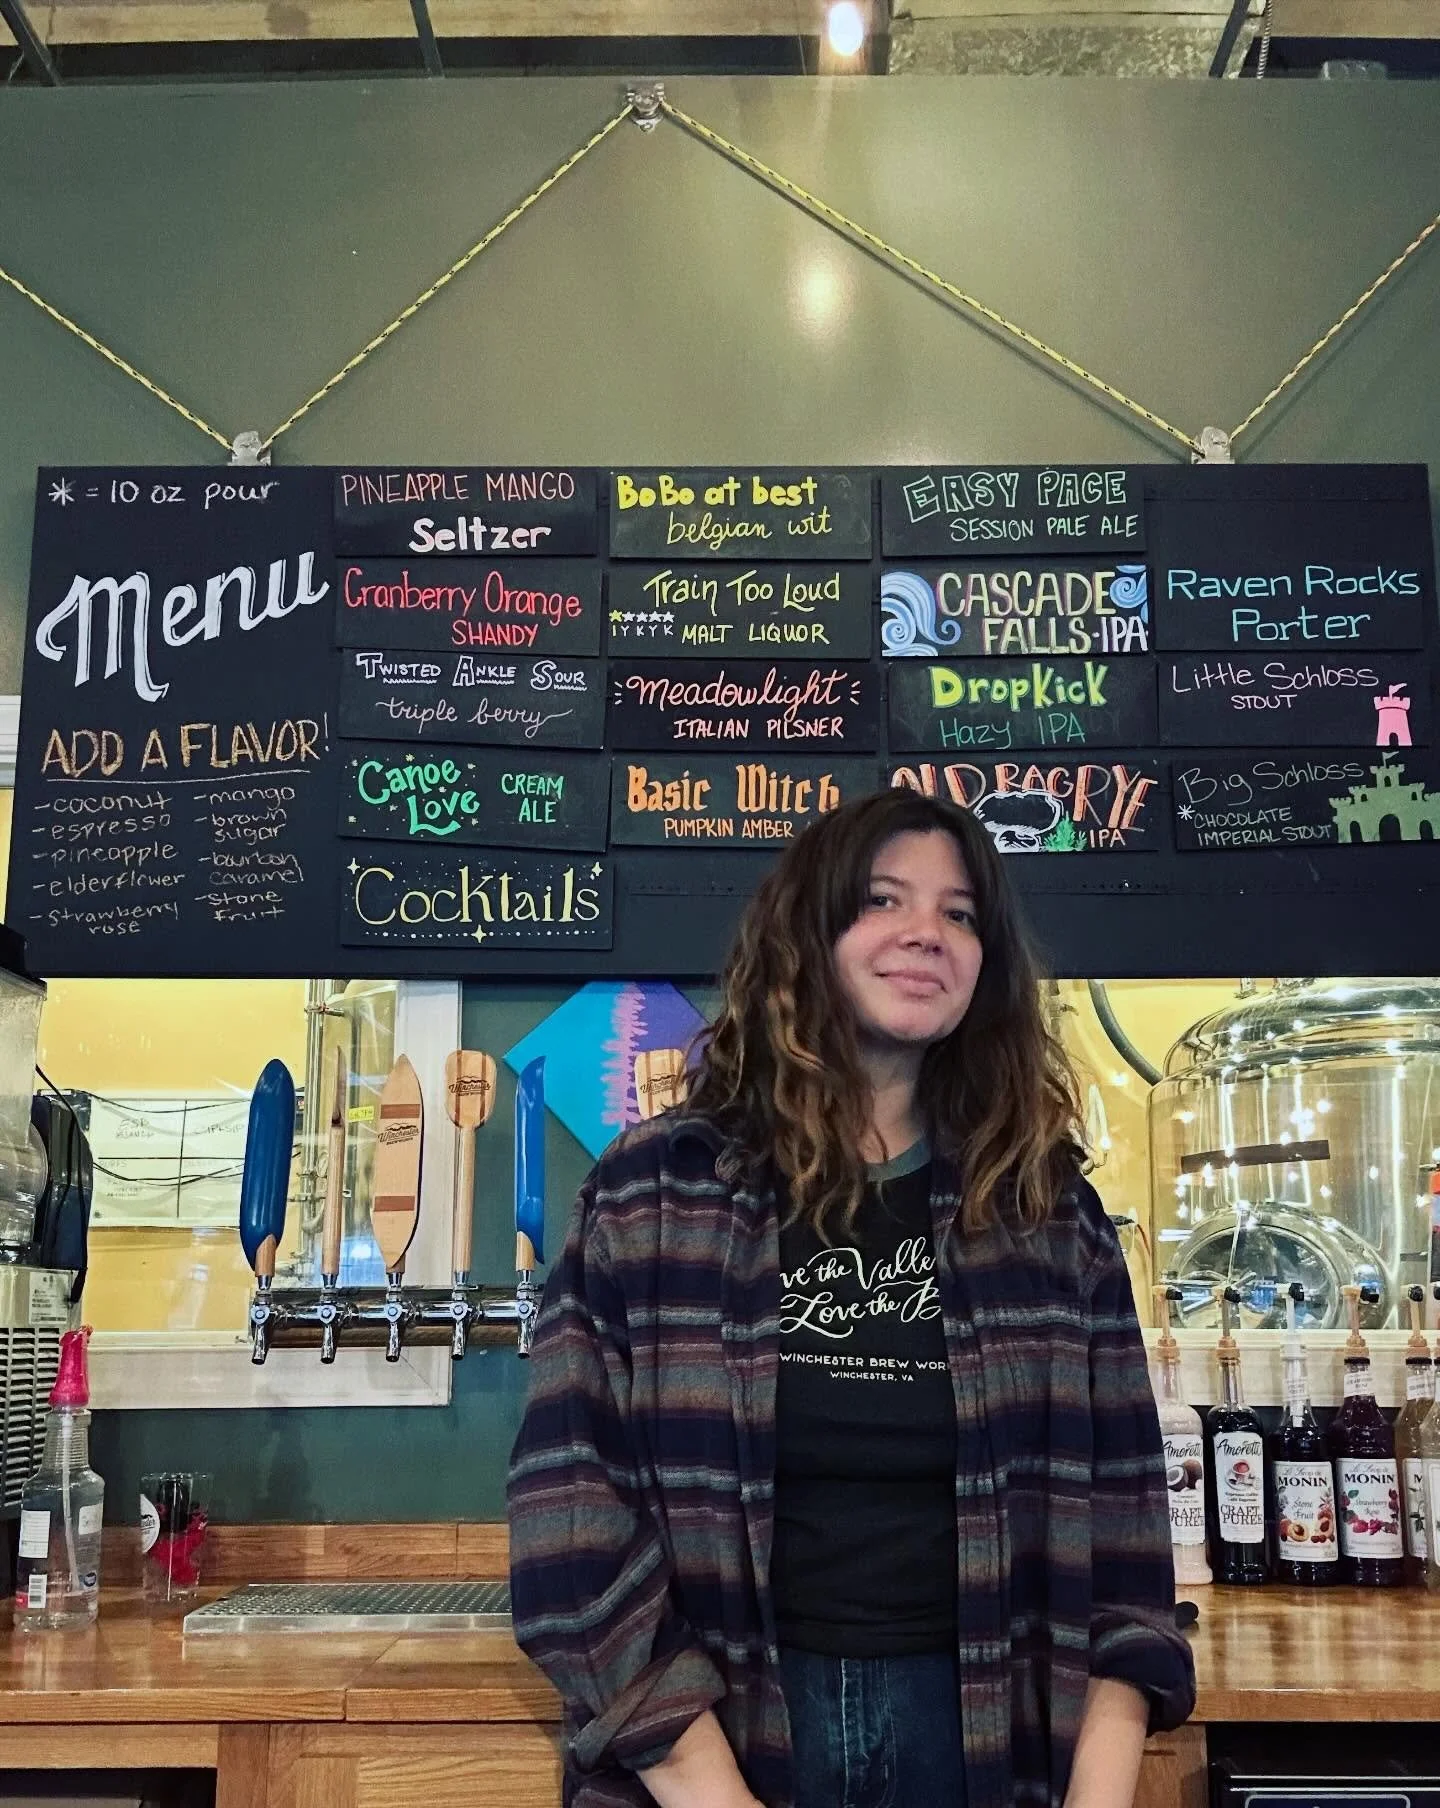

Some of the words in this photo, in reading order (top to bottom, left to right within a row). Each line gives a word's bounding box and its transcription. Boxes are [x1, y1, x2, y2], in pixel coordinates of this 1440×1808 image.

[111, 480, 139, 503] 10
[151, 484, 185, 504] oz
[204, 481, 280, 509] pour
[341, 473, 469, 506] PINEAPPLE
[486, 472, 576, 502] MANGO
[617, 474, 695, 510] BoBo
[704, 476, 741, 506] at
[752, 475, 818, 506] best
[903, 471, 1019, 523] EASY
[1037, 470, 1126, 508] PACE
[408, 516, 552, 552] Seltzer
[666, 511, 773, 551] belgian
[788, 505, 832, 535] wit
[949, 517, 1033, 542] SESSION
[1047, 514, 1090, 537] PALE
[1101, 514, 1138, 538] ALE
[344, 567, 477, 617] Cranberry
[484, 570, 582, 626] Orange
[643, 569, 719, 617] Train
[726, 569, 774, 606] Too
[783, 572, 841, 613] Loud
[936, 570, 1116, 618] CASCADE
[1167, 569, 1292, 599] Raven
[1304, 565, 1420, 596] Rocks
[35, 551, 330, 702] Menu
[451, 620, 538, 647] SHANDY
[681, 624, 733, 645] MALT
[748, 623, 830, 645] LIQUOR
[1232, 606, 1370, 642] Porter
[1173, 662, 1256, 693] Little
[1264, 662, 1379, 690] Schloss
[625, 667, 848, 722] Meadowlight
[1230, 694, 1297, 710] STOUT
[375, 697, 458, 734] triple
[467, 698, 573, 738] berry
[673, 718, 750, 739] ITALIAN
[766, 716, 844, 739] PILSNER
[940, 718, 1013, 749] Hazy
[1039, 712, 1086, 745] IPA
[41, 728, 125, 778] ADD
[140, 728, 168, 773] A
[180, 712, 330, 769] FLAVOR!
[358, 759, 462, 805] Canoe
[501, 773, 564, 800] CREAM
[627, 765, 712, 813] Basic
[735, 763, 841, 814] Witch
[1178, 767, 1253, 806] Big
[1252, 761, 1365, 790] Schloss
[407, 789, 480, 835] Love
[518, 797, 557, 824] ALE
[214, 824, 286, 845] sugar
[664, 818, 734, 838] PUMPKIN
[741, 819, 795, 839] AMBER
[1090, 829, 1126, 848] IPA
[1197, 826, 1281, 847] IMPERIAL
[1282, 824, 1332, 842] STOUT
[355, 866, 600, 925] Cocktails
[89, 922, 140, 935] rose
[779, 1267, 811, 1289] ve
[807, 1236, 937, 1290] Valle
[814, 1257, 852, 1282] the
[779, 1291, 866, 1338] Love
[865, 1291, 901, 1316] the
[779, 1352, 865, 1367] WINCHESTER
[869, 1358, 909, 1369] BREW
[915, 1360, 949, 1371] WOR
[830, 1371, 898, 1383] WINCHESTER,
[901, 1374, 914, 1382] VA
[1278, 1475, 1328, 1487] MONIN
[1344, 1473, 1395, 1484] MONIN
[1169, 1508, 1203, 1518] RAFT
[1220, 1504, 1260, 1516] CRAFT
